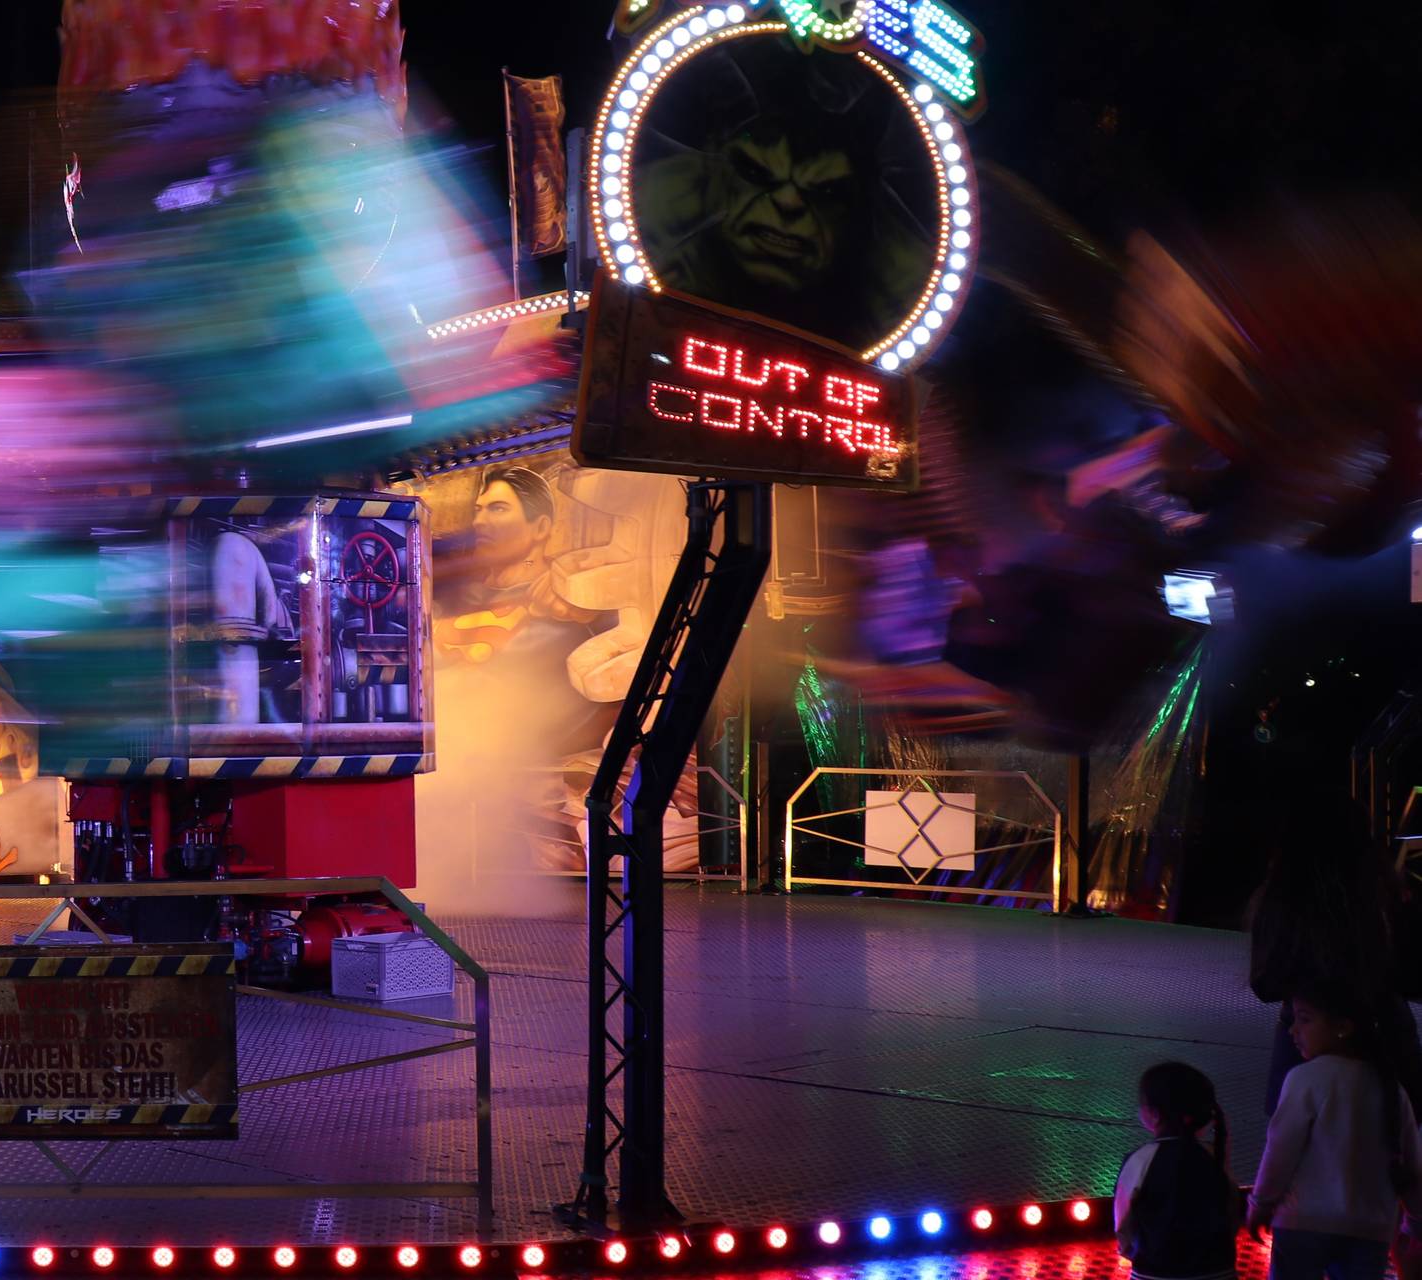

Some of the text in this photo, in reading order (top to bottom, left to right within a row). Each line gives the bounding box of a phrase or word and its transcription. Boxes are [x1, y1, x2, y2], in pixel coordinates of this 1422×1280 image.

[684, 336, 881, 416] OUT OF
[649, 380, 900, 454] CONTROL
[33, 1013, 79, 1041] UND
[79, 1043, 116, 1070] BIS
[120, 1043, 164, 1070] DAS
[101, 1071, 177, 1099] STEHT!
[26, 1108, 123, 1123] HEROES
